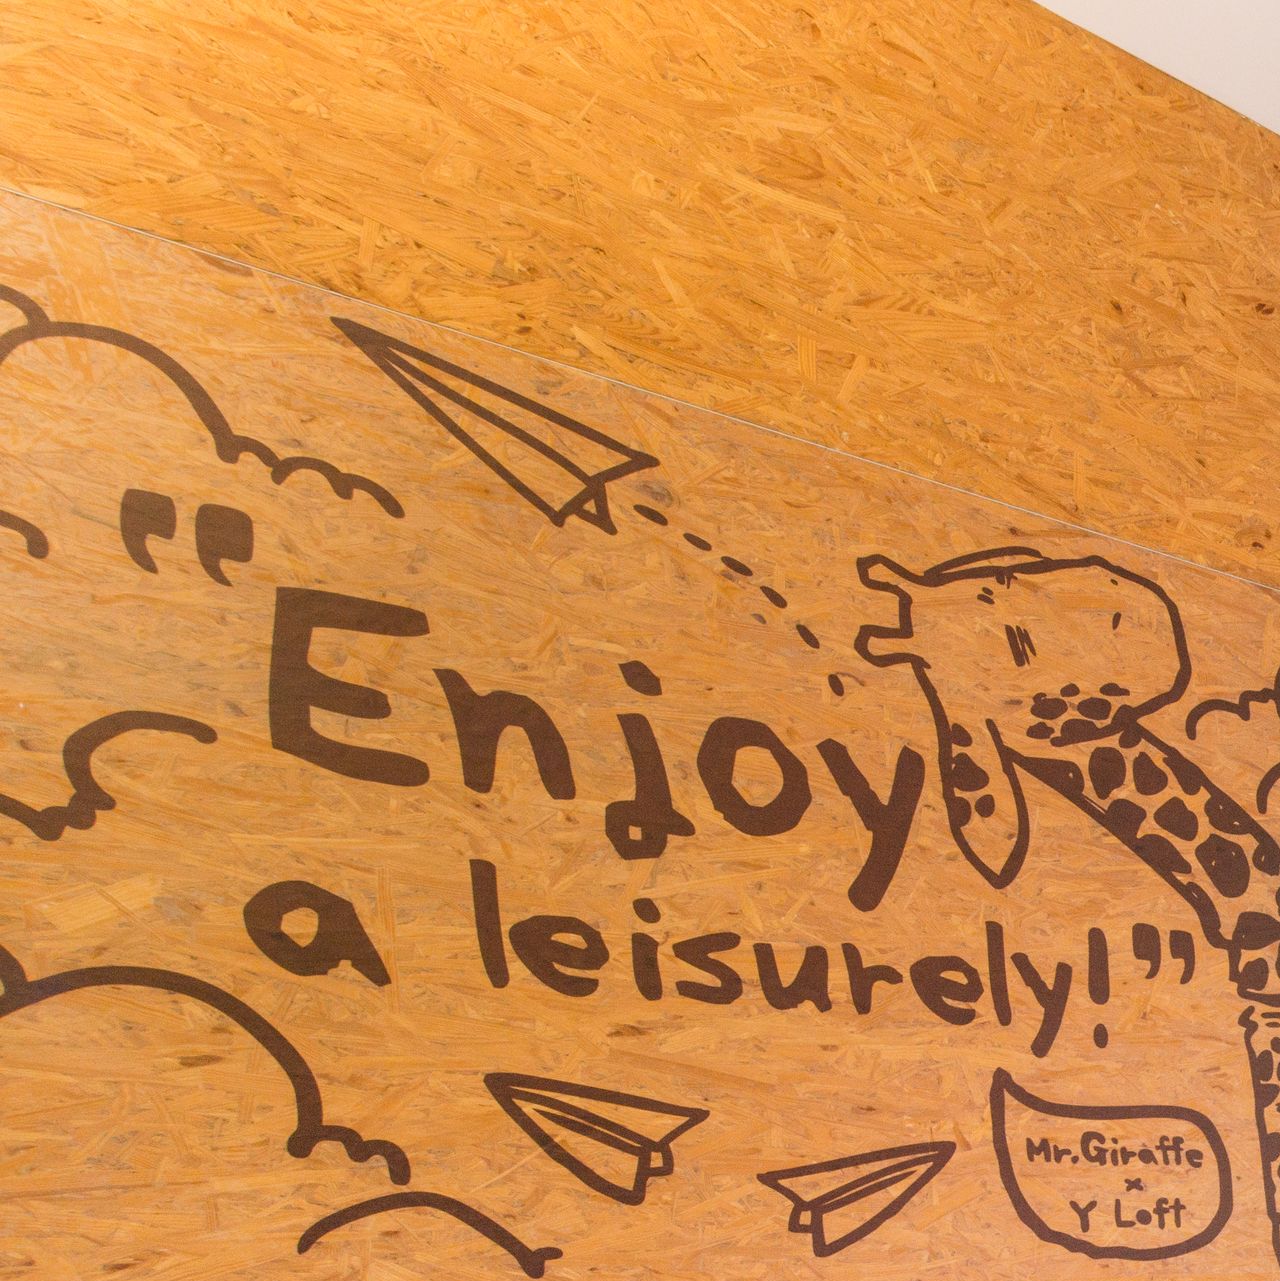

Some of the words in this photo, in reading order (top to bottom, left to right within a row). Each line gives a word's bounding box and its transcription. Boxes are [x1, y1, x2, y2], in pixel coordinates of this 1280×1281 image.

[243, 880, 392, 987] a
[1069, 1200, 1098, 1233] Y
[1114, 1197, 1187, 1230] Loft
